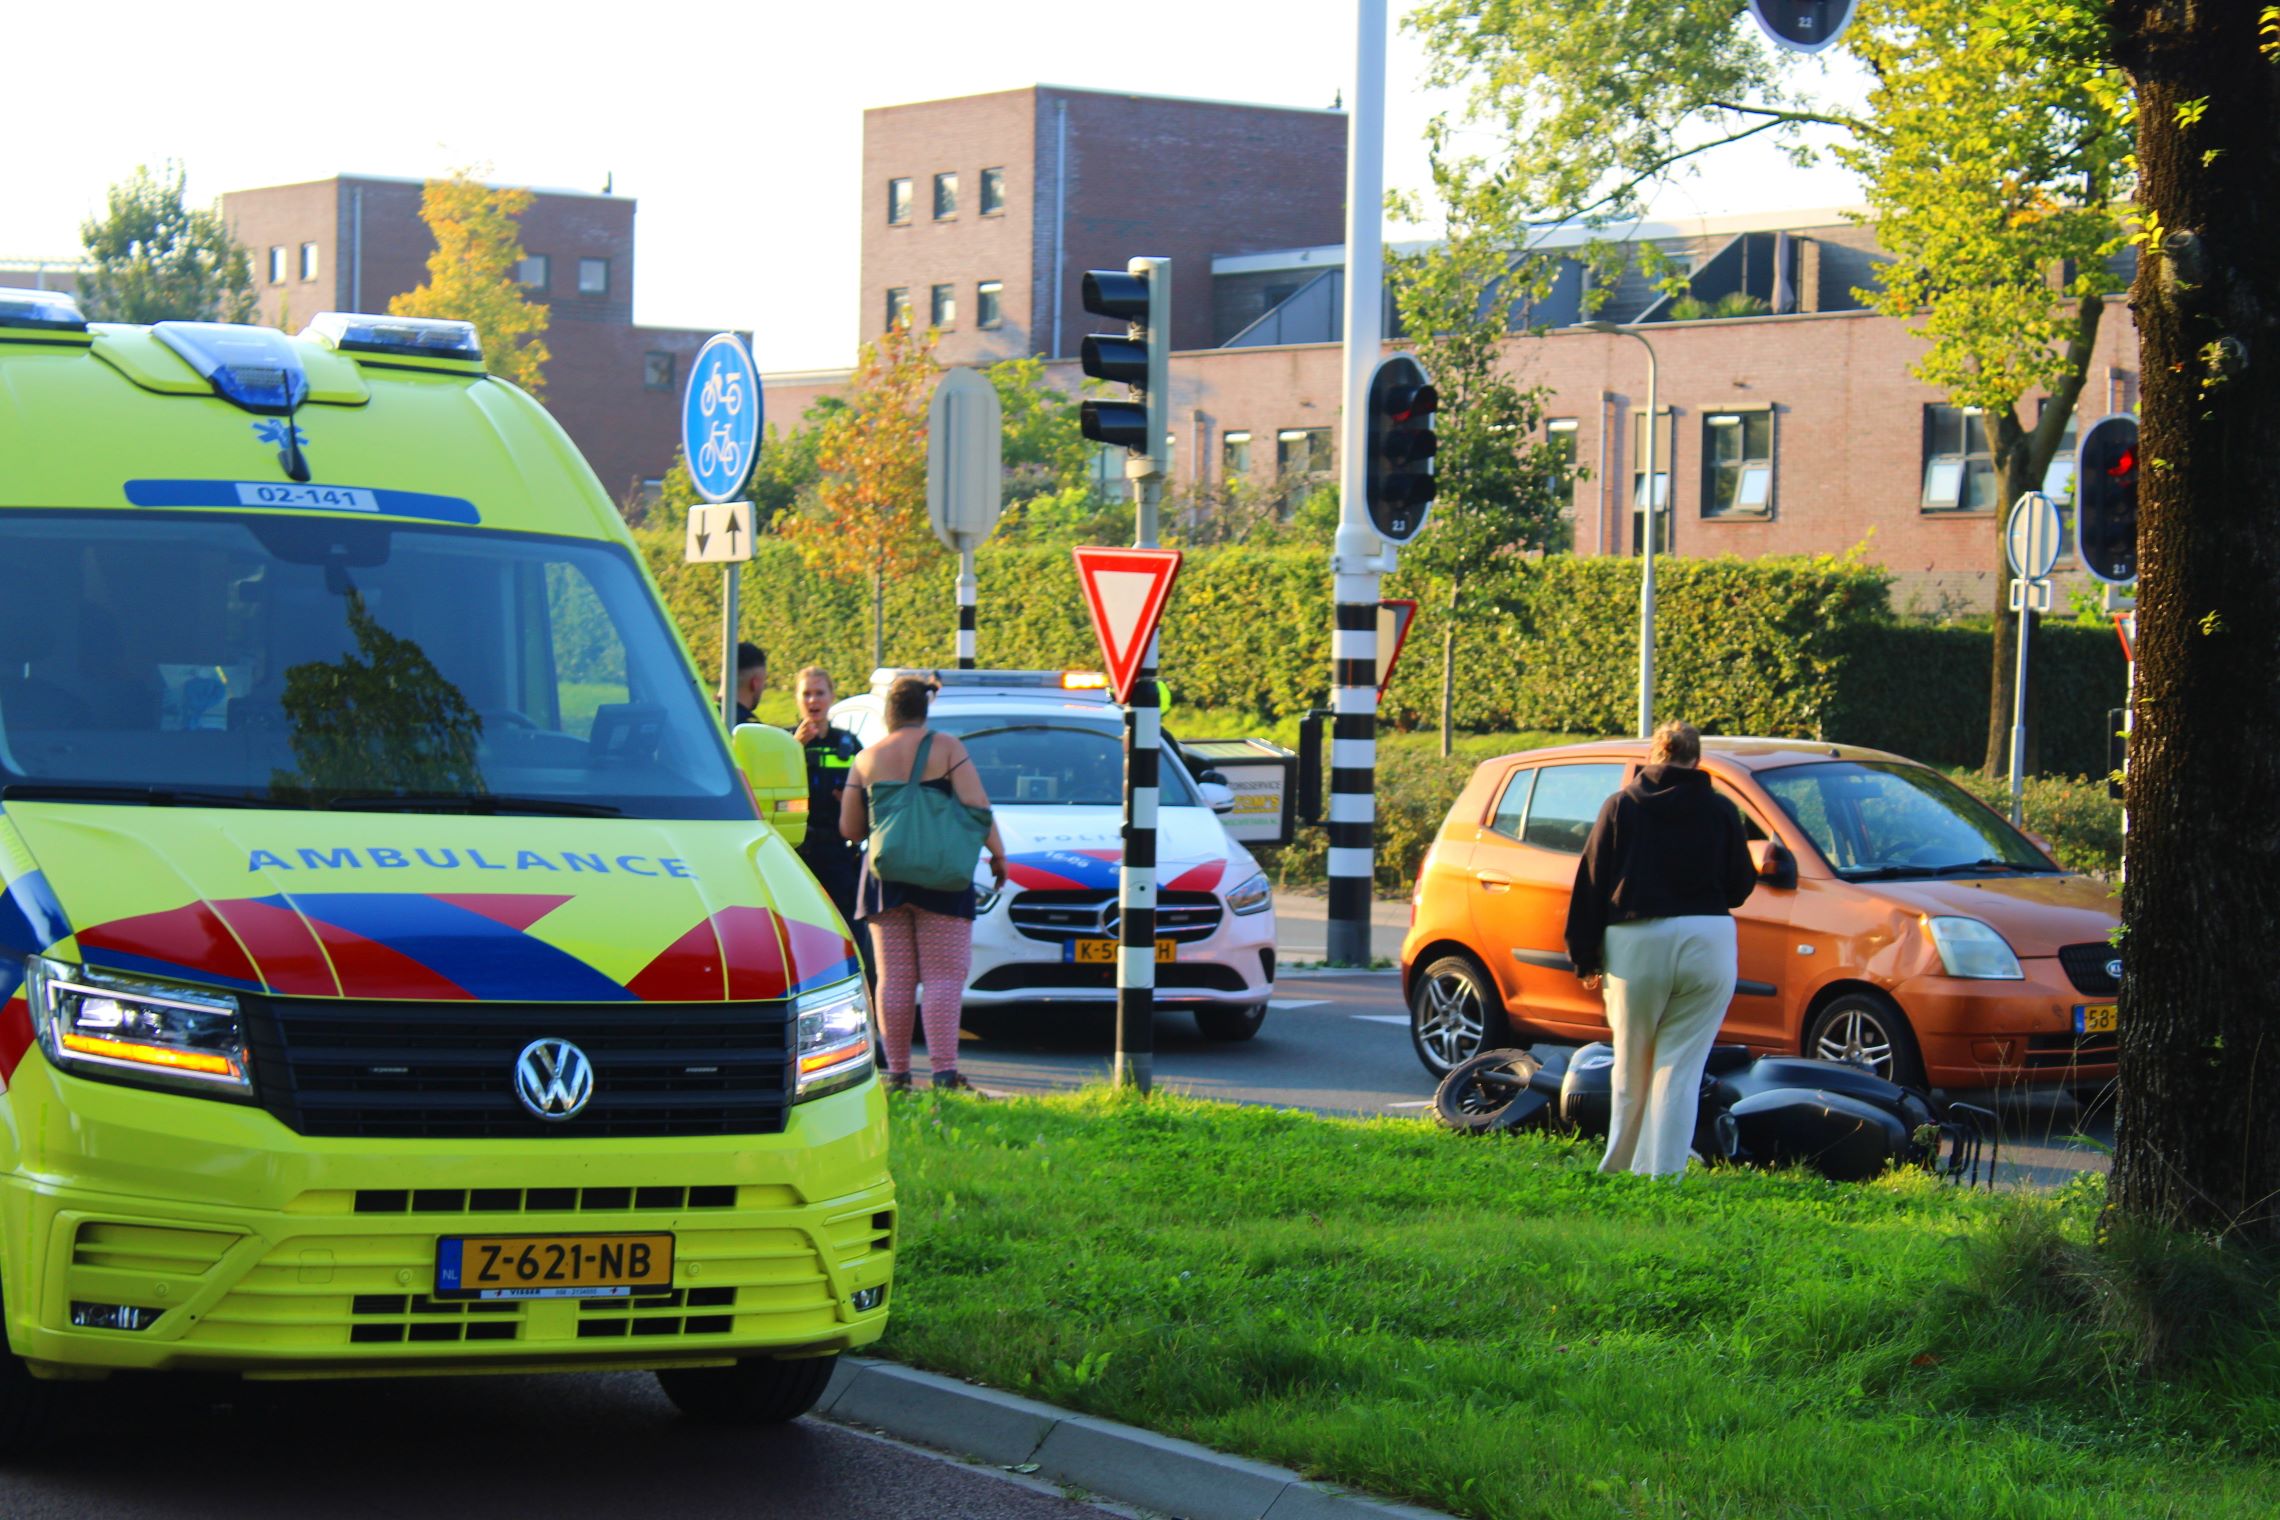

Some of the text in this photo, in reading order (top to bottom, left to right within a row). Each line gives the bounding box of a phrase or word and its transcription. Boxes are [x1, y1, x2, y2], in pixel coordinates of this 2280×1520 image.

[256, 486, 357, 507] 02-141
[1034, 834, 1122, 844] POLIT
[248, 847, 699, 880] AMBULANCE
[478, 1243, 651, 1281] Z-621-NB
[442, 1269, 458, 1280] NL
